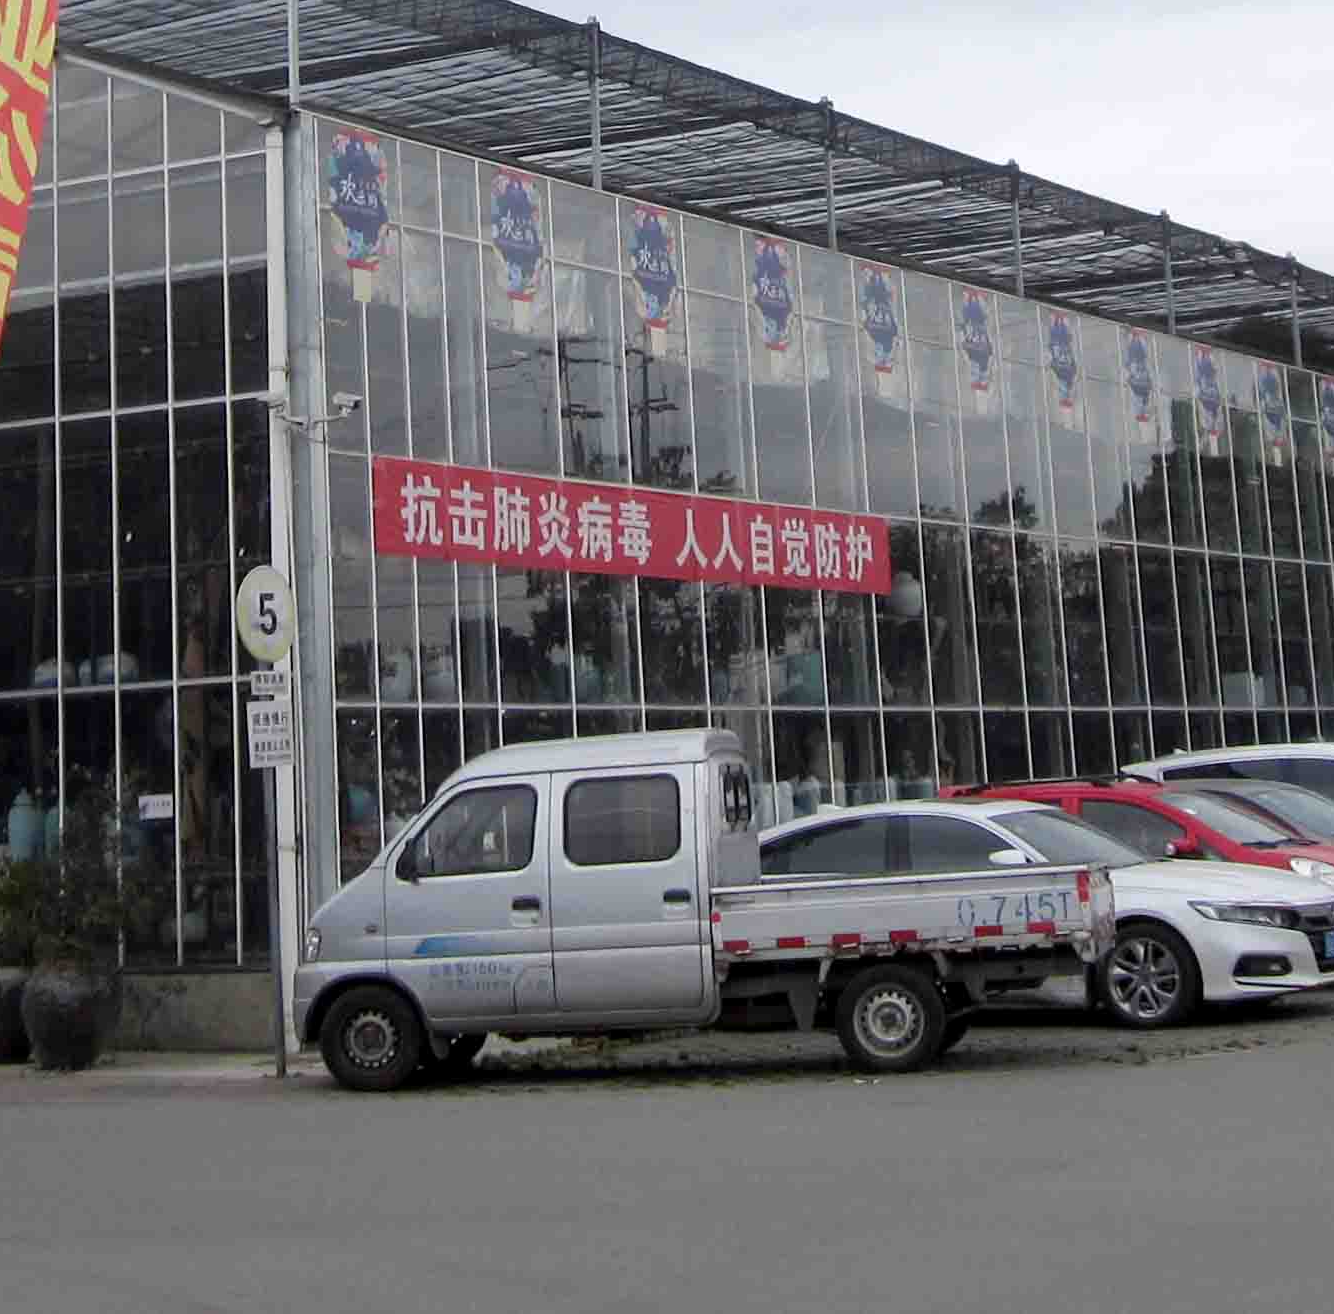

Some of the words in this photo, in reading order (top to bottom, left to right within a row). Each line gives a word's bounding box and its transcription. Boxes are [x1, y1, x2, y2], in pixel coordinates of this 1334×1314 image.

[400, 474, 653, 567] 抗击肺炎病毒
[676, 509, 875, 584] 人人自觉防护
[259, 592, 278, 636] 5
